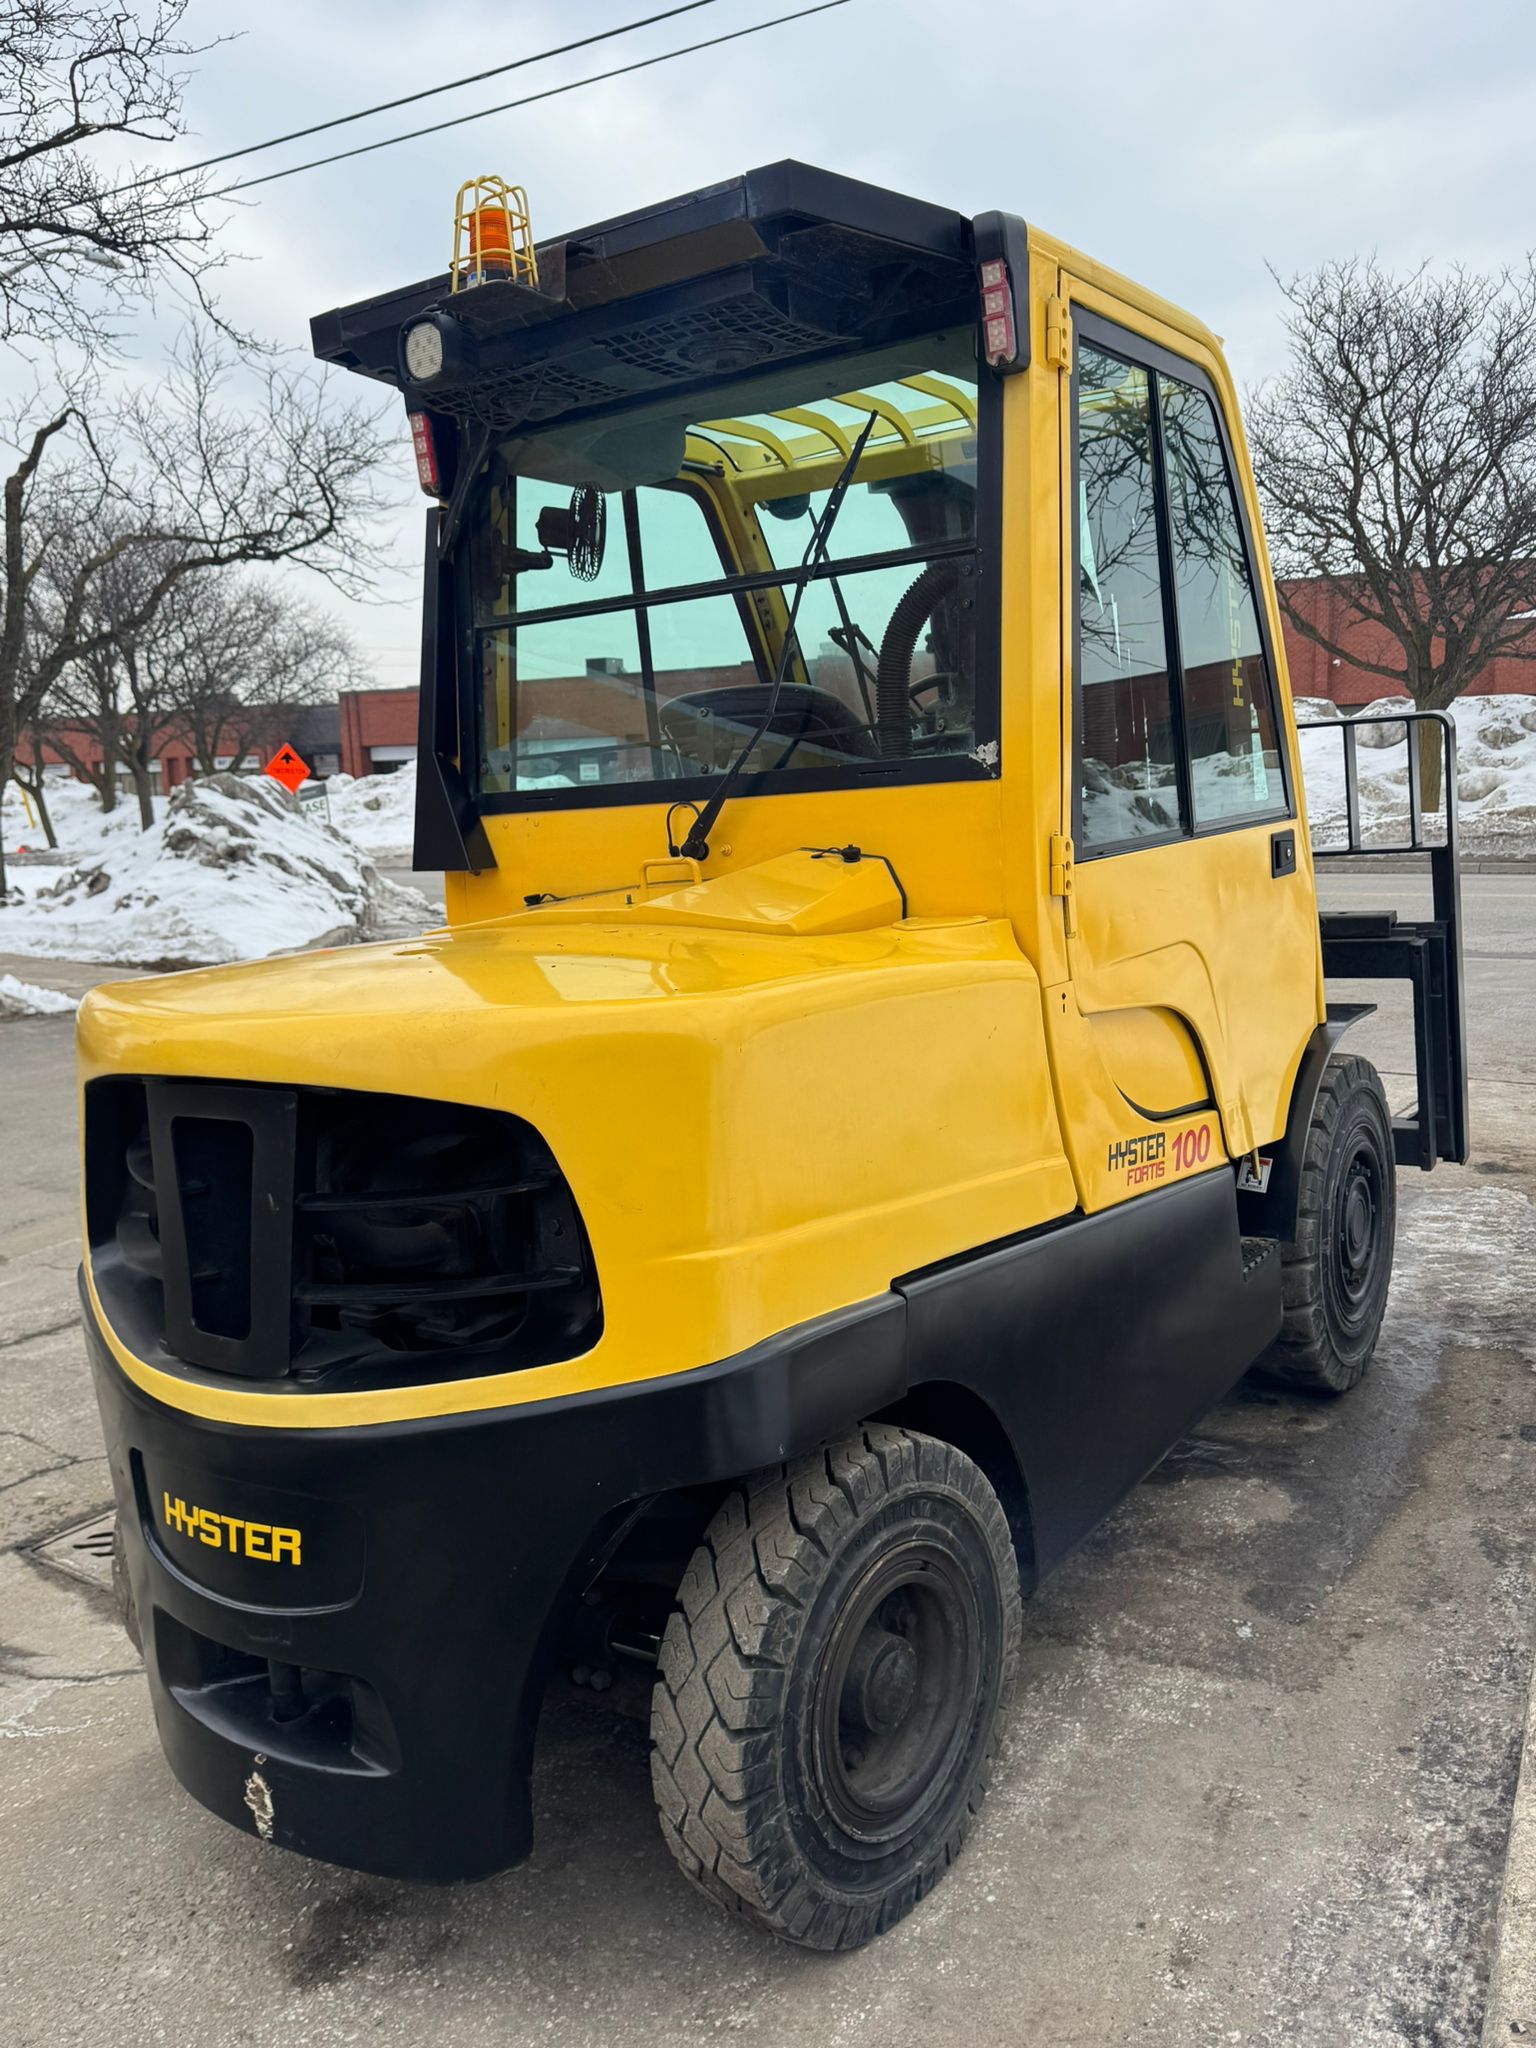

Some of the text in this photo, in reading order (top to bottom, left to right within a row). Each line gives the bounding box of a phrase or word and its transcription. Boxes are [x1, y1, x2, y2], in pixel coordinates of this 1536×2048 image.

[1227, 558, 1244, 707] HYST
[1108, 1124, 1211, 1172] HYSTER 100
[1127, 1161, 1165, 1187] FORTIS
[164, 1491, 301, 1566] HYSTER
